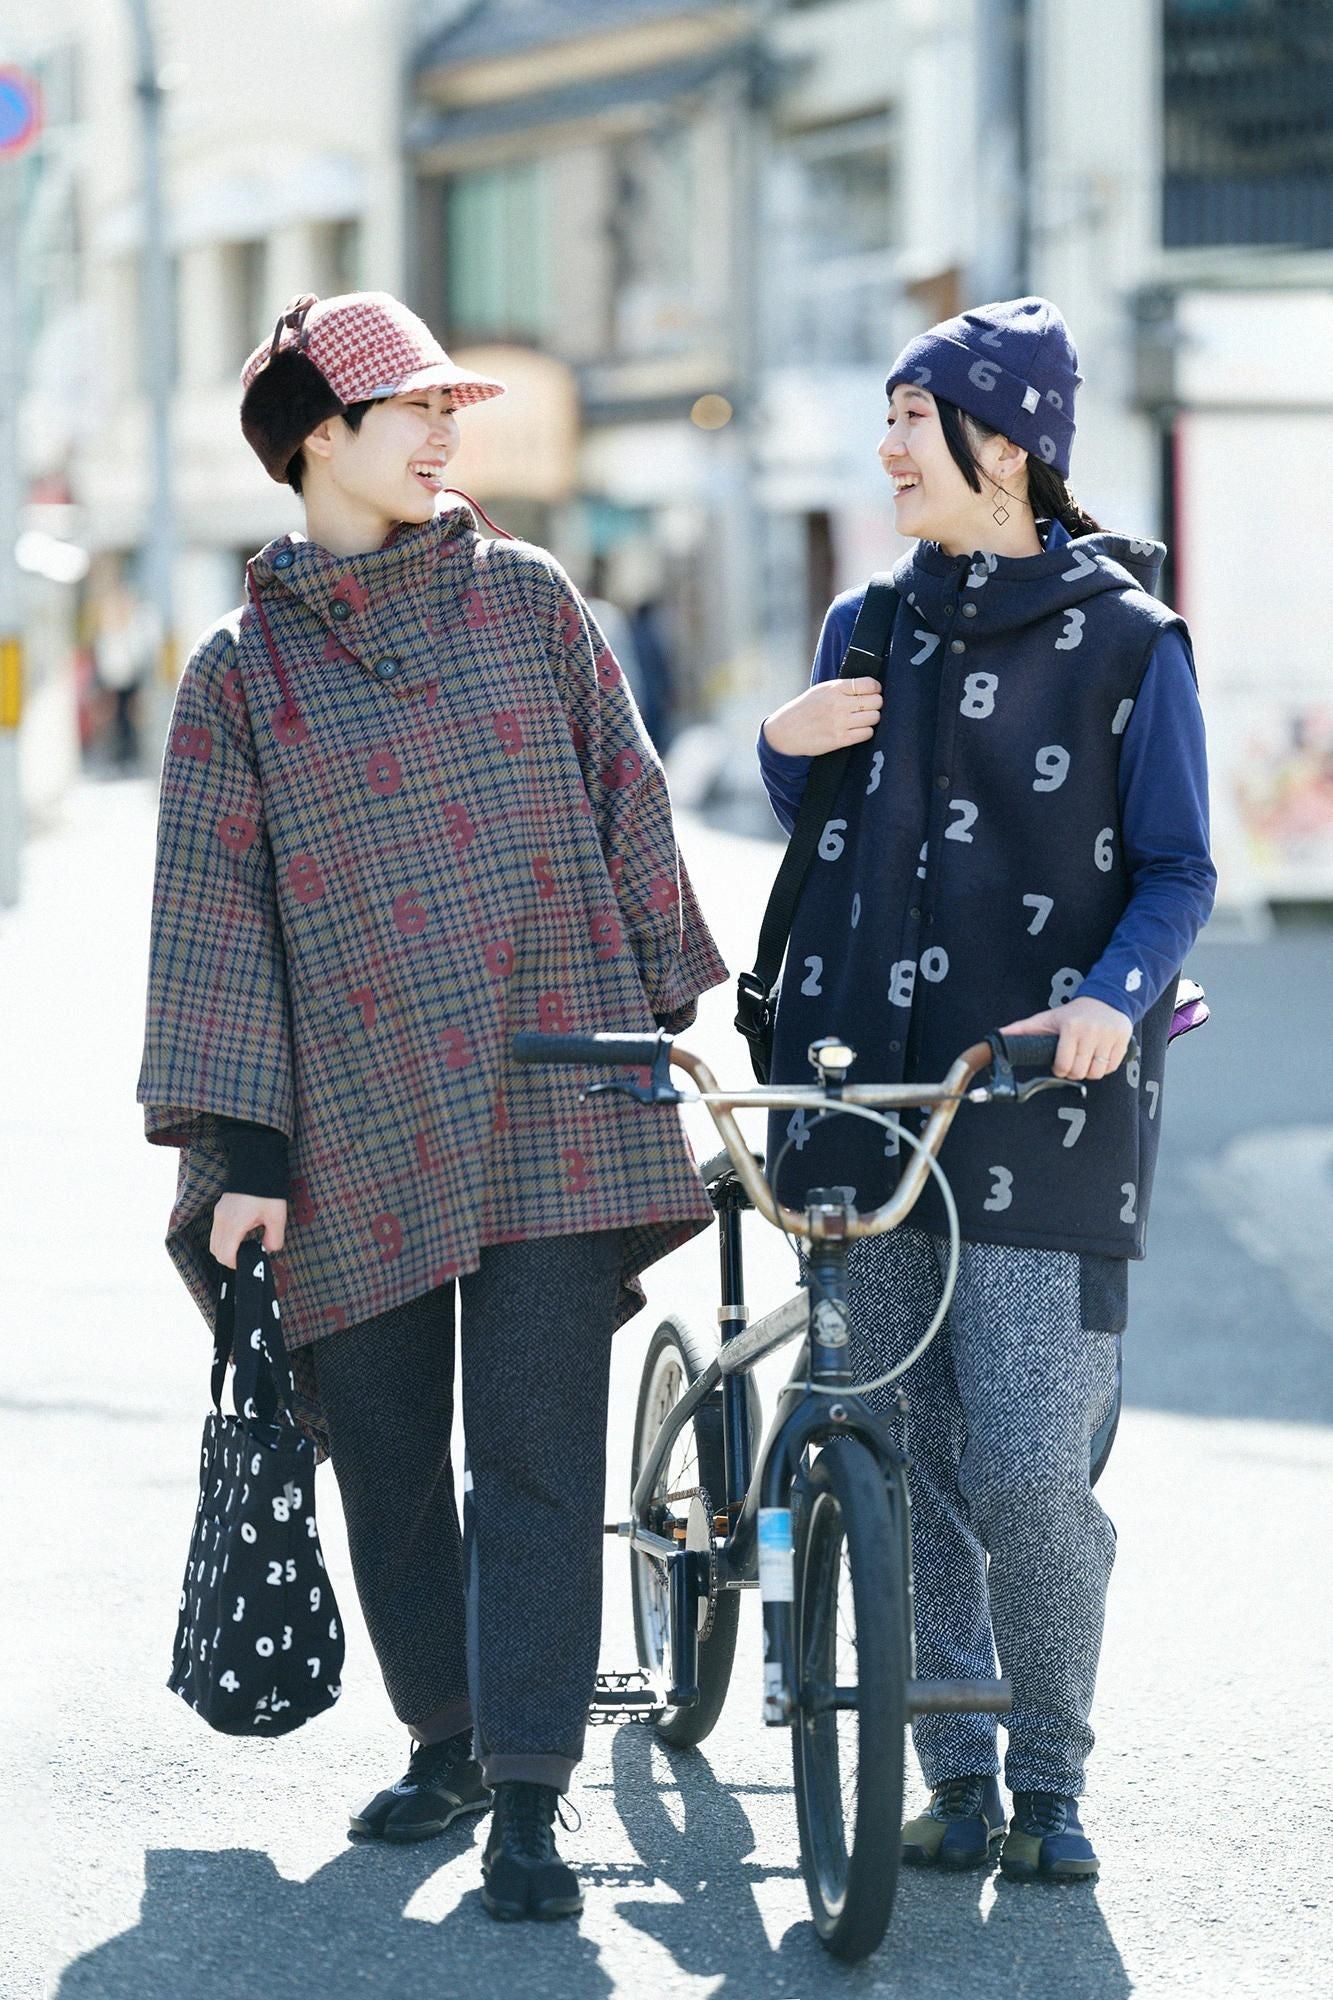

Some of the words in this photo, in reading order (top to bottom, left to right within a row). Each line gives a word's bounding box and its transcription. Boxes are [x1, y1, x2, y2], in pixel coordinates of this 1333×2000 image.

[967, 359, 1002, 392] 6
[1061, 549, 1098, 582] 7
[910, 629, 941, 666] 7
[1054, 608, 1086, 651] 3
[960, 672, 999, 719] 8
[493, 711, 524, 756] 9
[367, 752, 402, 796] 0
[865, 750, 885, 796] 3
[1032, 745, 1071, 792] 9
[817, 819, 848, 862] 6
[944, 799, 979, 843] 2
[1094, 827, 1114, 872] 6
[288, 854, 325, 904] 8
[392, 889, 427, 936] 6
[1022, 893, 1054, 936] 7
[590, 914, 623, 960] 9
[484, 939, 515, 978] 0
[801, 955, 824, 997] 2
[919, 946, 949, 983] 0
[347, 986, 377, 1031] 7
[1049, 967, 1086, 1009] 8
[1145, 1080, 1160, 1120] 7
[786, 1108, 811, 1151] 4
[1057, 1107, 1087, 1148] 7
[561, 1148, 588, 1194] 3
[983, 1165, 1014, 1212] 3
[1119, 1182, 1137, 1225] 2
[372, 1212, 403, 1264] 9
[250, 1452, 262, 1476] 6
[271, 1496, 290, 1523] 8
[305, 1516, 317, 1539] 2
[241, 1522, 257, 1545] 0
[232, 1596, 245, 1622] 3
[309, 1586, 321, 1613] 9
[255, 1636, 275, 1658] 0
[281, 1625, 293, 1651] 3
[219, 1669, 241, 1693] 4
[306, 1657, 321, 1679] 7
